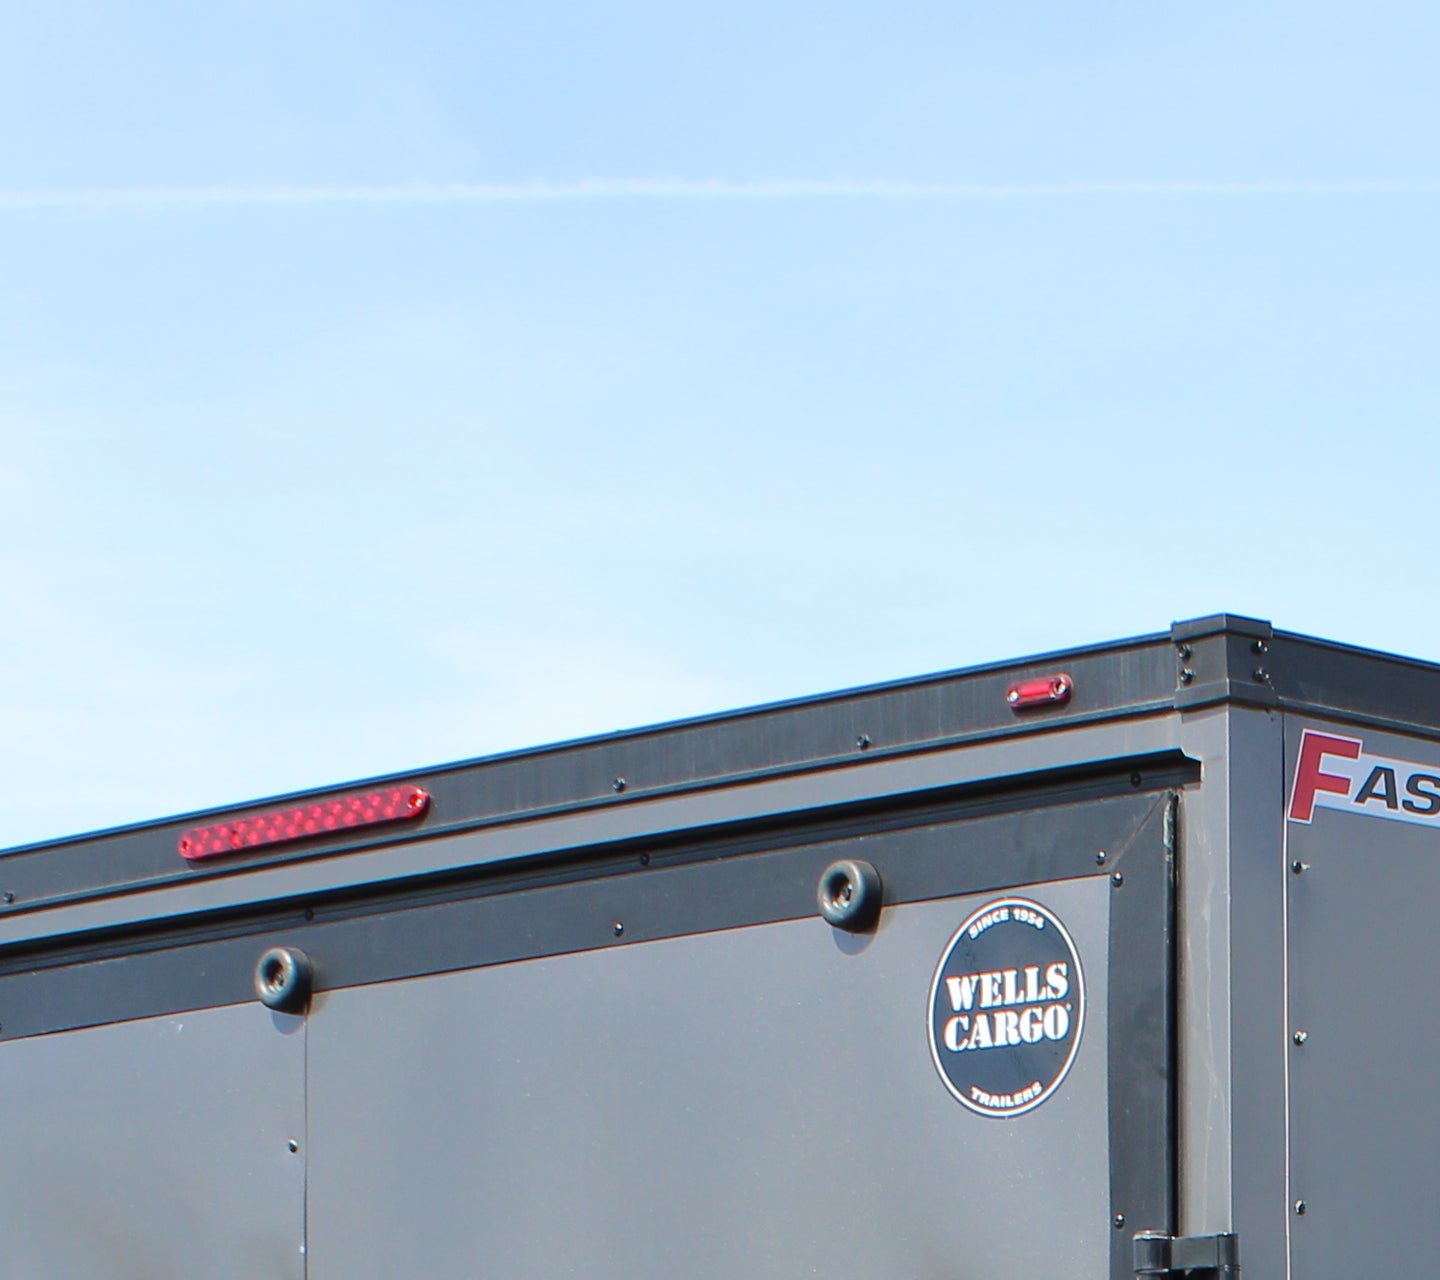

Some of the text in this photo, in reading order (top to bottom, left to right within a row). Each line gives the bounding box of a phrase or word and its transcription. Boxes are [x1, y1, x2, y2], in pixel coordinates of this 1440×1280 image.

[967, 908, 1045, 939] SINCE 1954
[945, 962, 1069, 1012] WELLS
[943, 1004, 1069, 1052] CARGO
[970, 1081, 1043, 1108] TRAILERS
